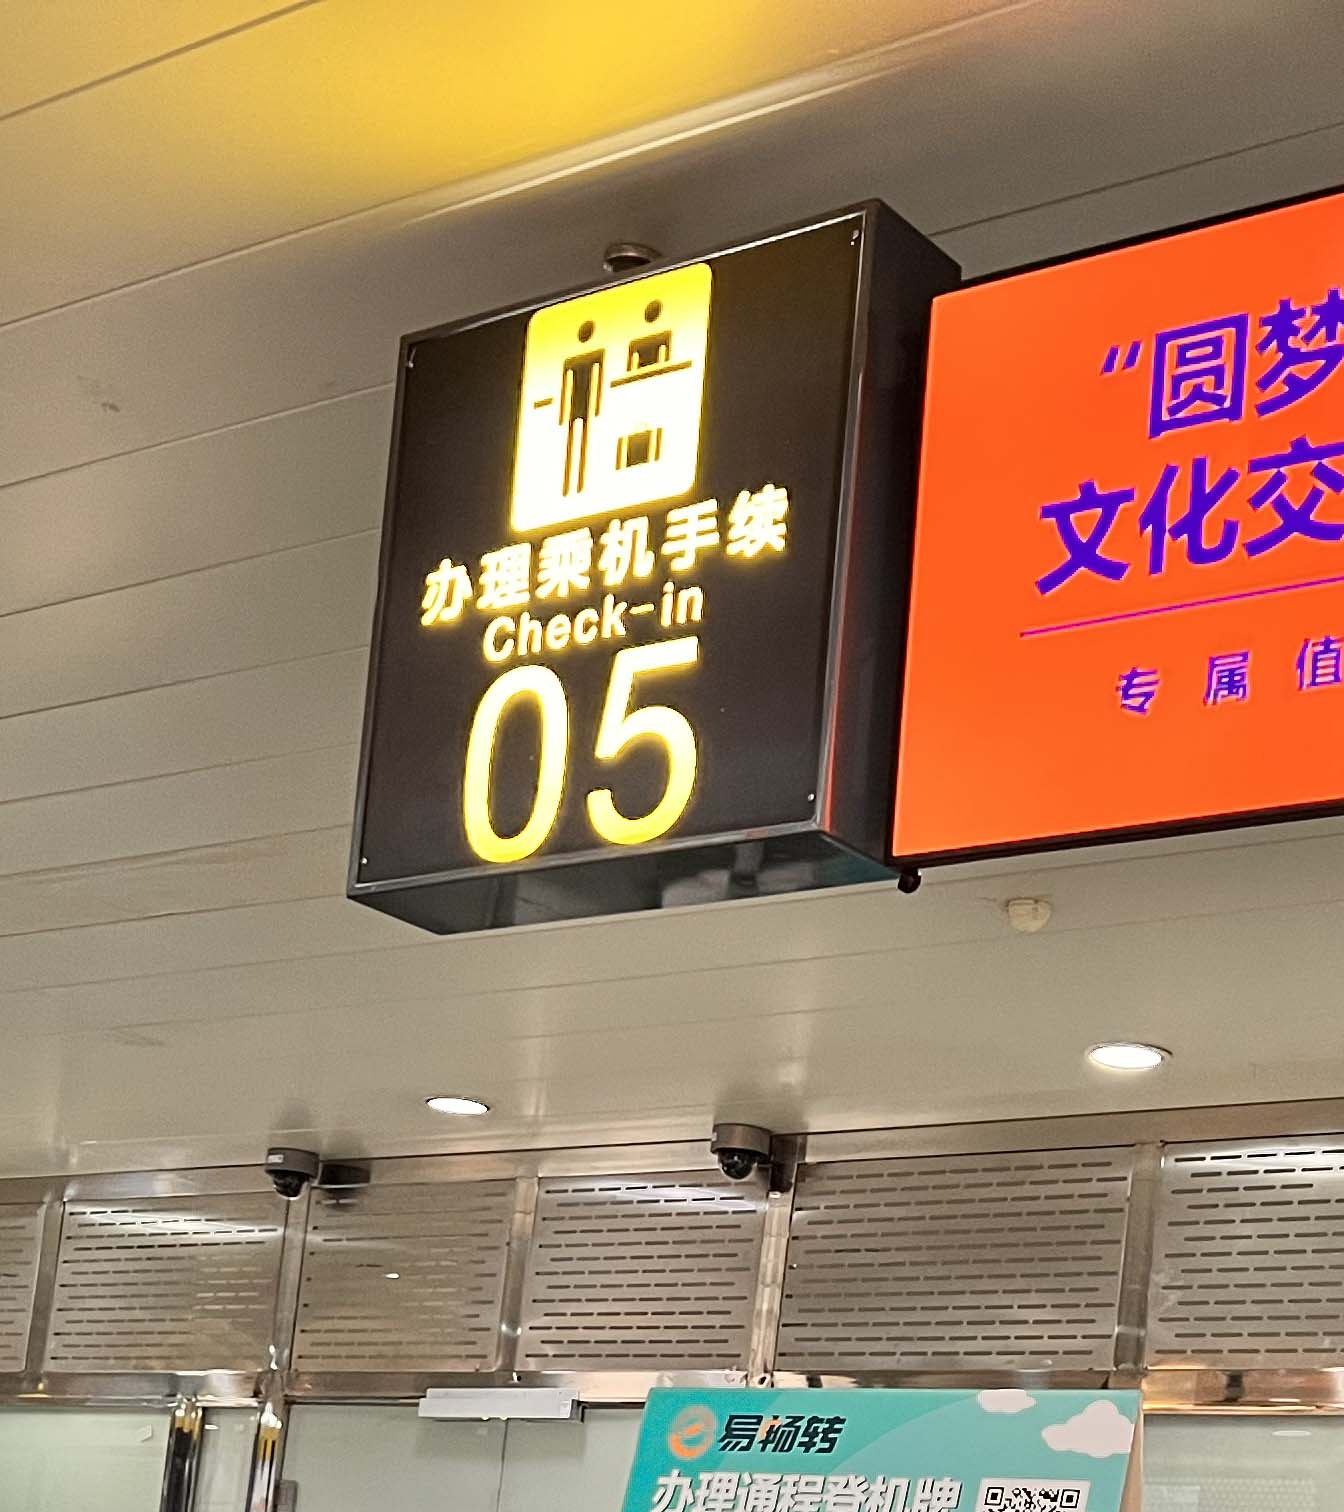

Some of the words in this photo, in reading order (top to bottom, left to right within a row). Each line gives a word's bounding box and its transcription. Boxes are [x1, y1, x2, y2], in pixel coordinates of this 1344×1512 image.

[420, 483, 790, 627] 办理乘机手续
[483, 581, 704, 663] Check-in
[463, 636, 700, 864] 05
[718, 1413, 847, 1454] 易畅转
